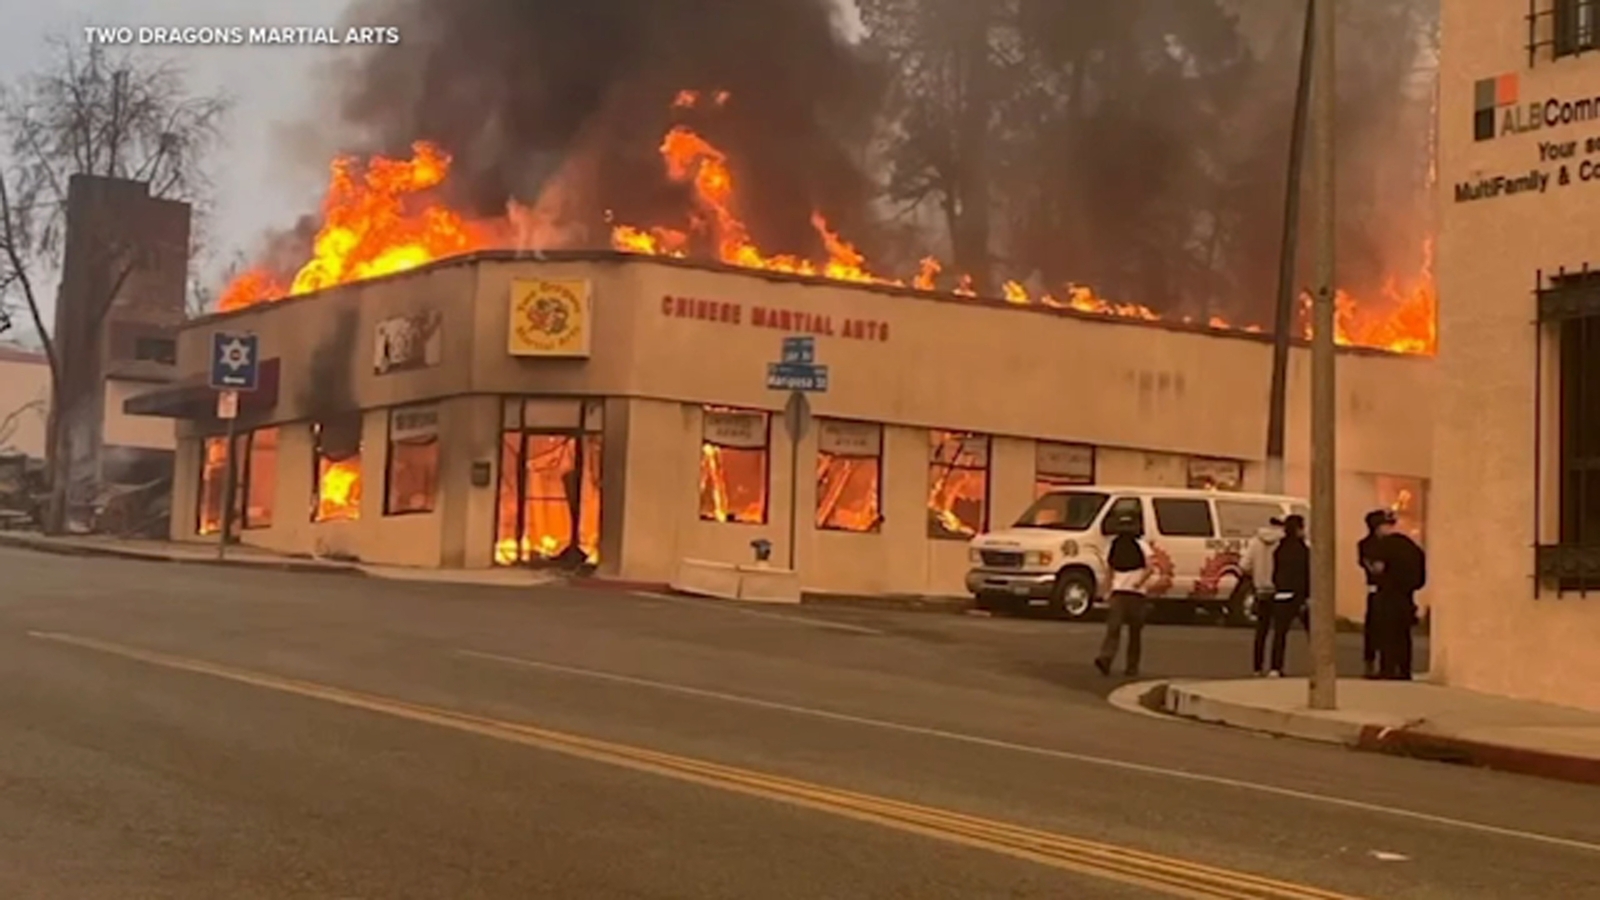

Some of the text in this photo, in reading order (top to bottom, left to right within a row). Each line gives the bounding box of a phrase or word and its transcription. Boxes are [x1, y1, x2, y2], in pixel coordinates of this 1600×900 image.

[1537, 141, 1577, 161] Your
[1454, 170, 1550, 203] MultiFamily
[1558, 164, 1570, 186] &
[661, 294, 890, 343] CHINESE MARTIAL ARTS
[768, 374, 813, 388] Mariposa
